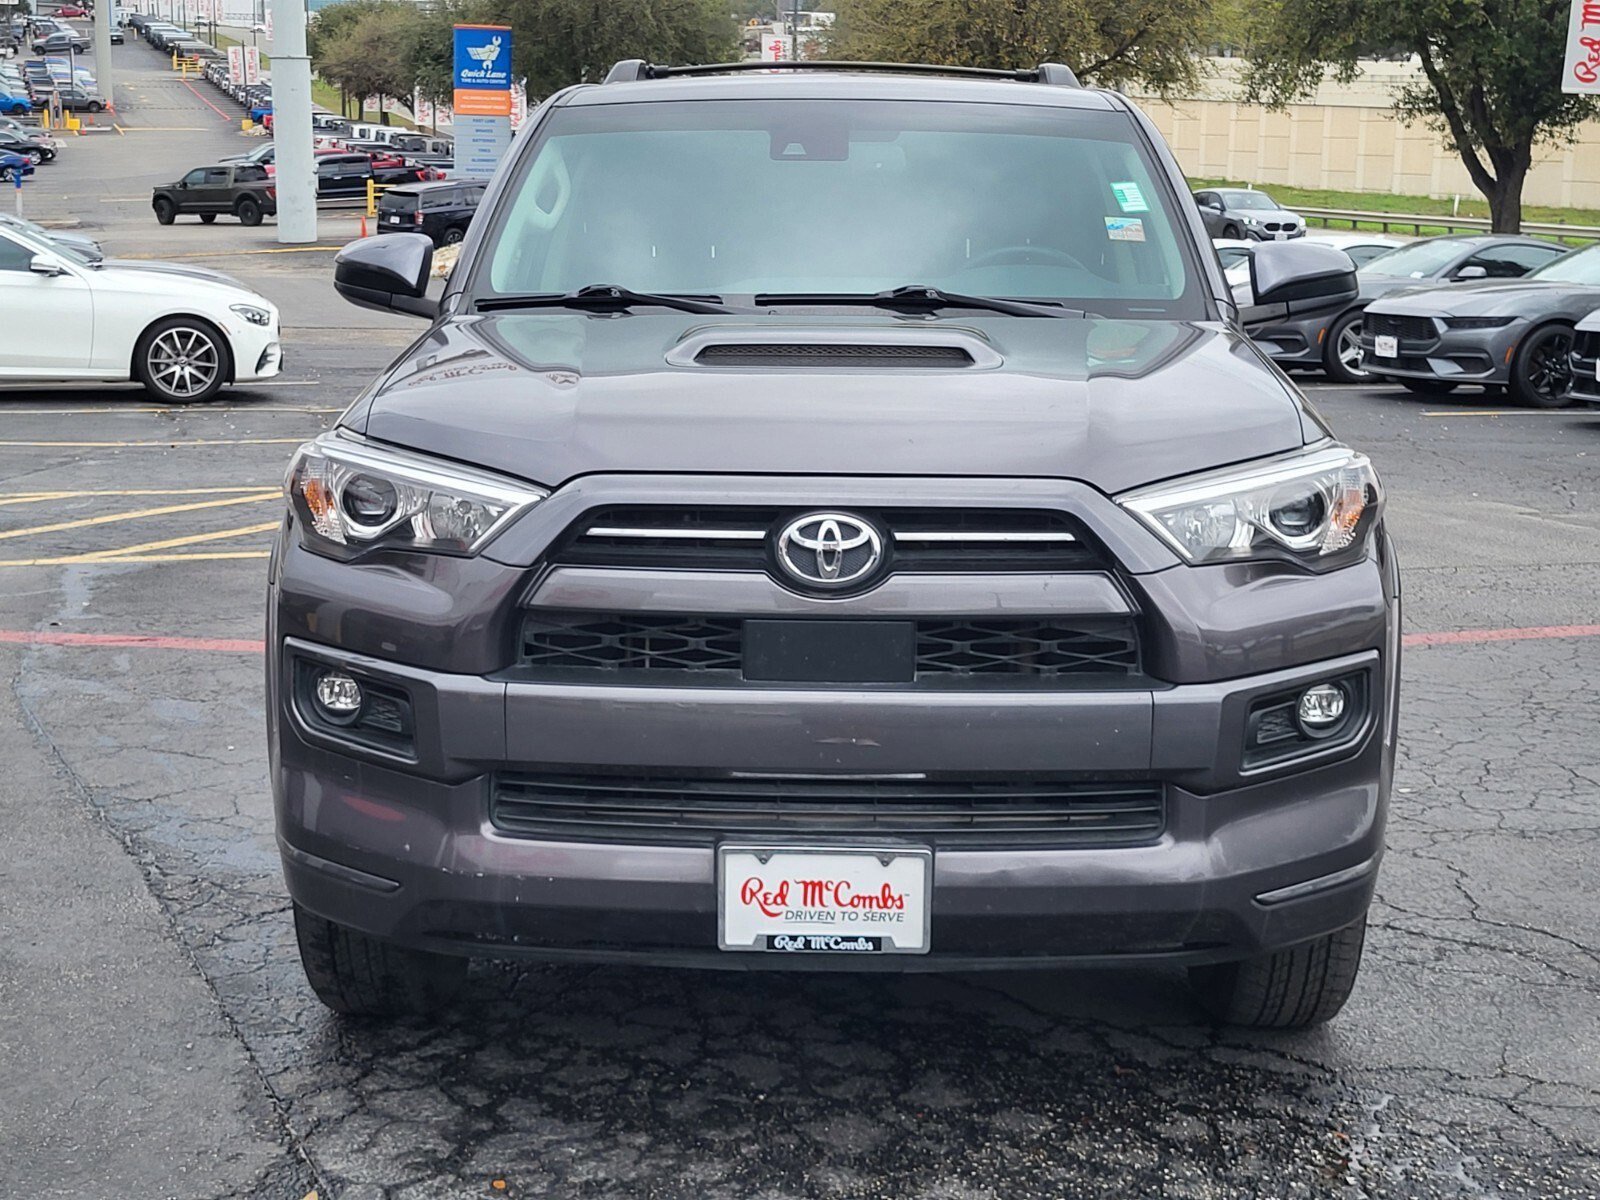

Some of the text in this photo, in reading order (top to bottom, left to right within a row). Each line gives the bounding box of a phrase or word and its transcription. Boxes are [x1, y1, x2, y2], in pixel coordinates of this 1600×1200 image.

[1574, 36, 1600, 83] Red
[461, 69, 507, 79] Quick Lane
[741, 877, 905, 917] Red McCombs
[784, 910, 905, 923] DRIVEN TO SERVE
[774, 935, 875, 951] Red McCombs
